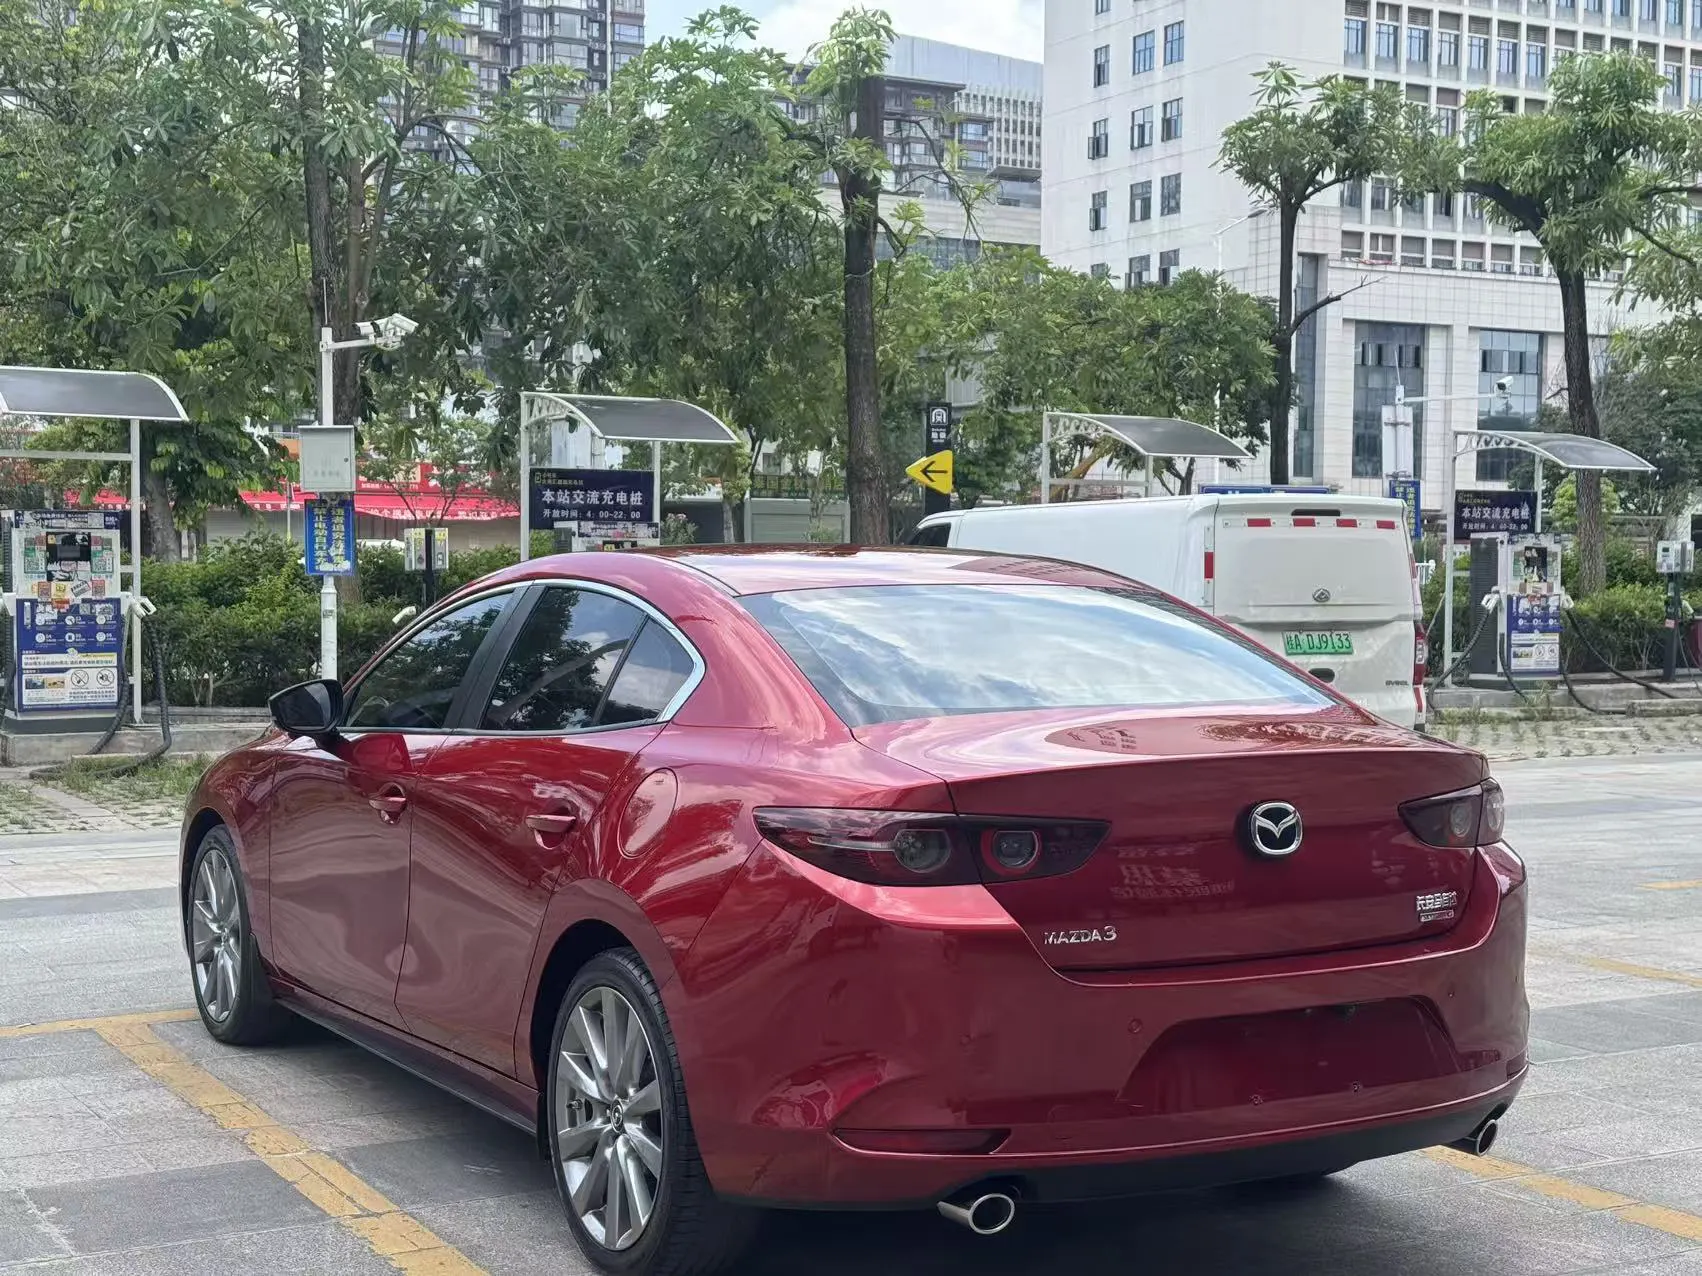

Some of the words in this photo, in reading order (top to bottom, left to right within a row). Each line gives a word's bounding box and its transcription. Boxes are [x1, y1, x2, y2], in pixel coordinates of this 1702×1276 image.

[542, 488, 642, 505] 本站交流充电桩
[1462, 503, 1530, 520] 本站交流充电桩
